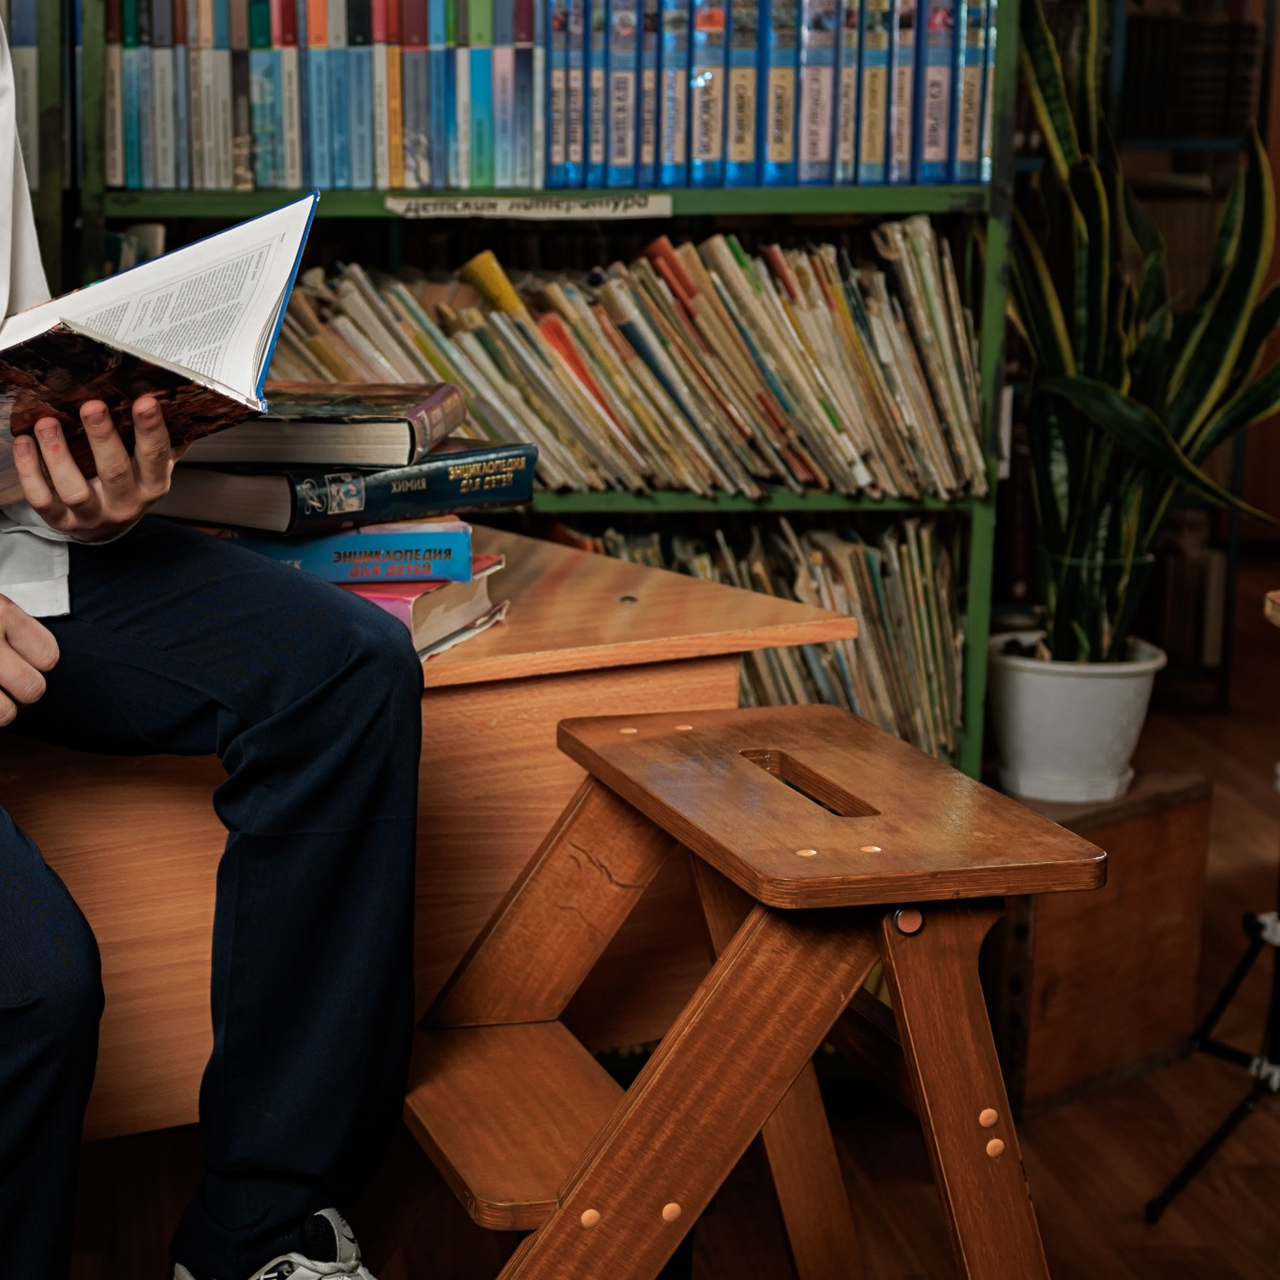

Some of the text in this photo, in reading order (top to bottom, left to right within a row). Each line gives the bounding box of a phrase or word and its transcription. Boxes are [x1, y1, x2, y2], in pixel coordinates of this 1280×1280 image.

[448, 457, 526, 480] ЭНЦИКЛОПЕДИЯ
[391, 477, 427, 494] ХИМИЯ
[458, 471, 515, 495] ДЛЯ ДЕТЕЙ
[332, 548, 453, 565] ЭНЦИКЛОПЕДИЯ
[349, 563, 433, 579] ДЛЯ ДЕТЕЙ
